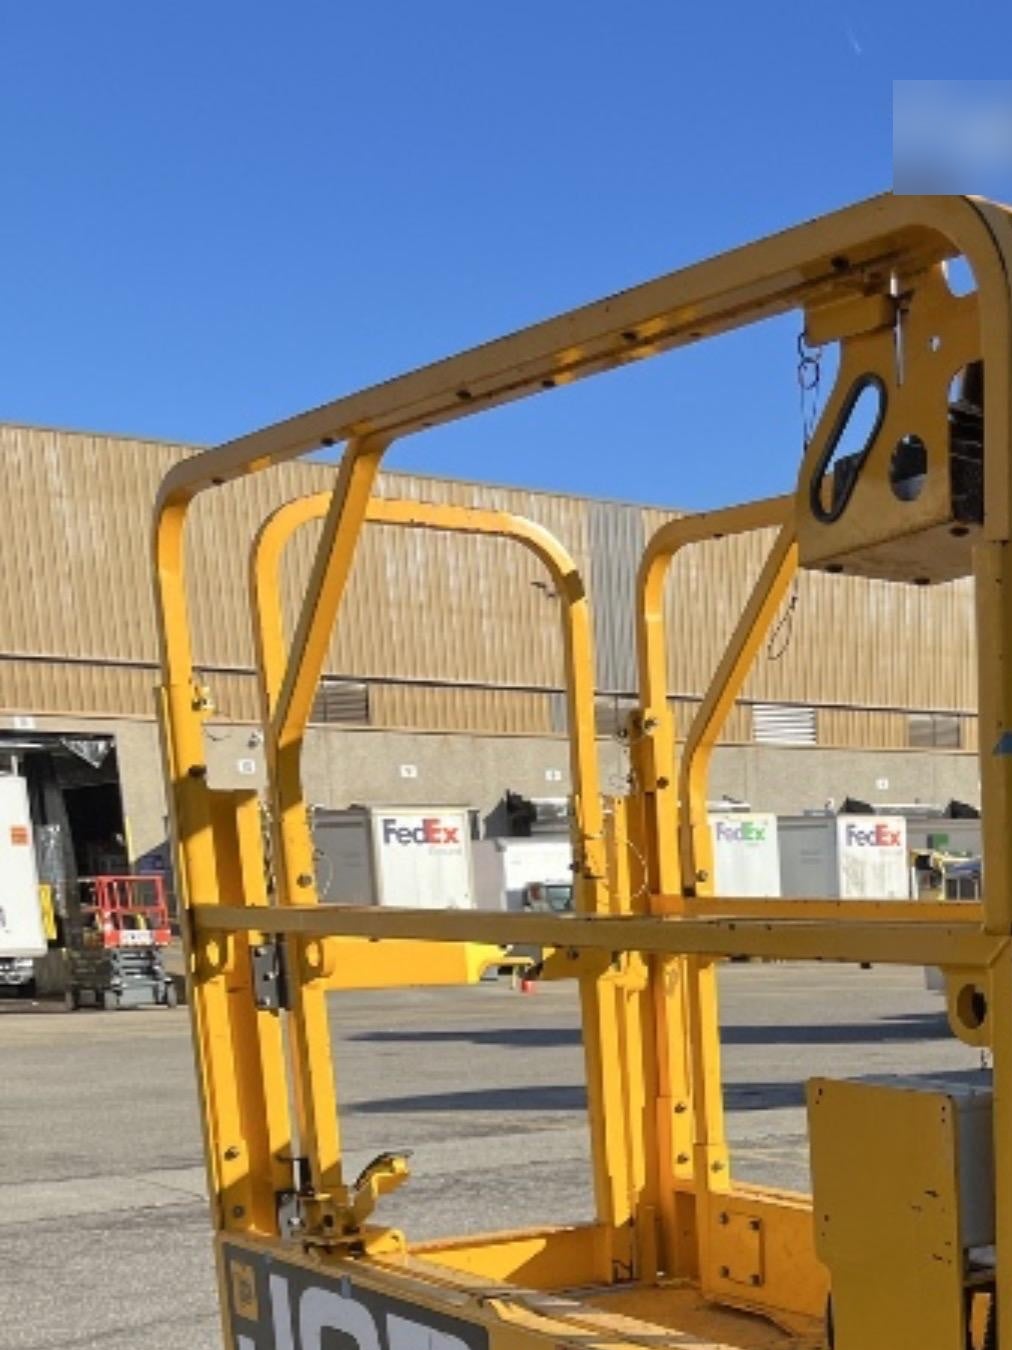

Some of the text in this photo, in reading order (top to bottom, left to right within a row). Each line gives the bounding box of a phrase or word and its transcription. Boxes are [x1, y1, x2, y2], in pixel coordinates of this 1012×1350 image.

[382, 818, 460, 846] FedEx
[715, 821, 767, 843] FedEx
[845, 824, 903, 848] FedEx
